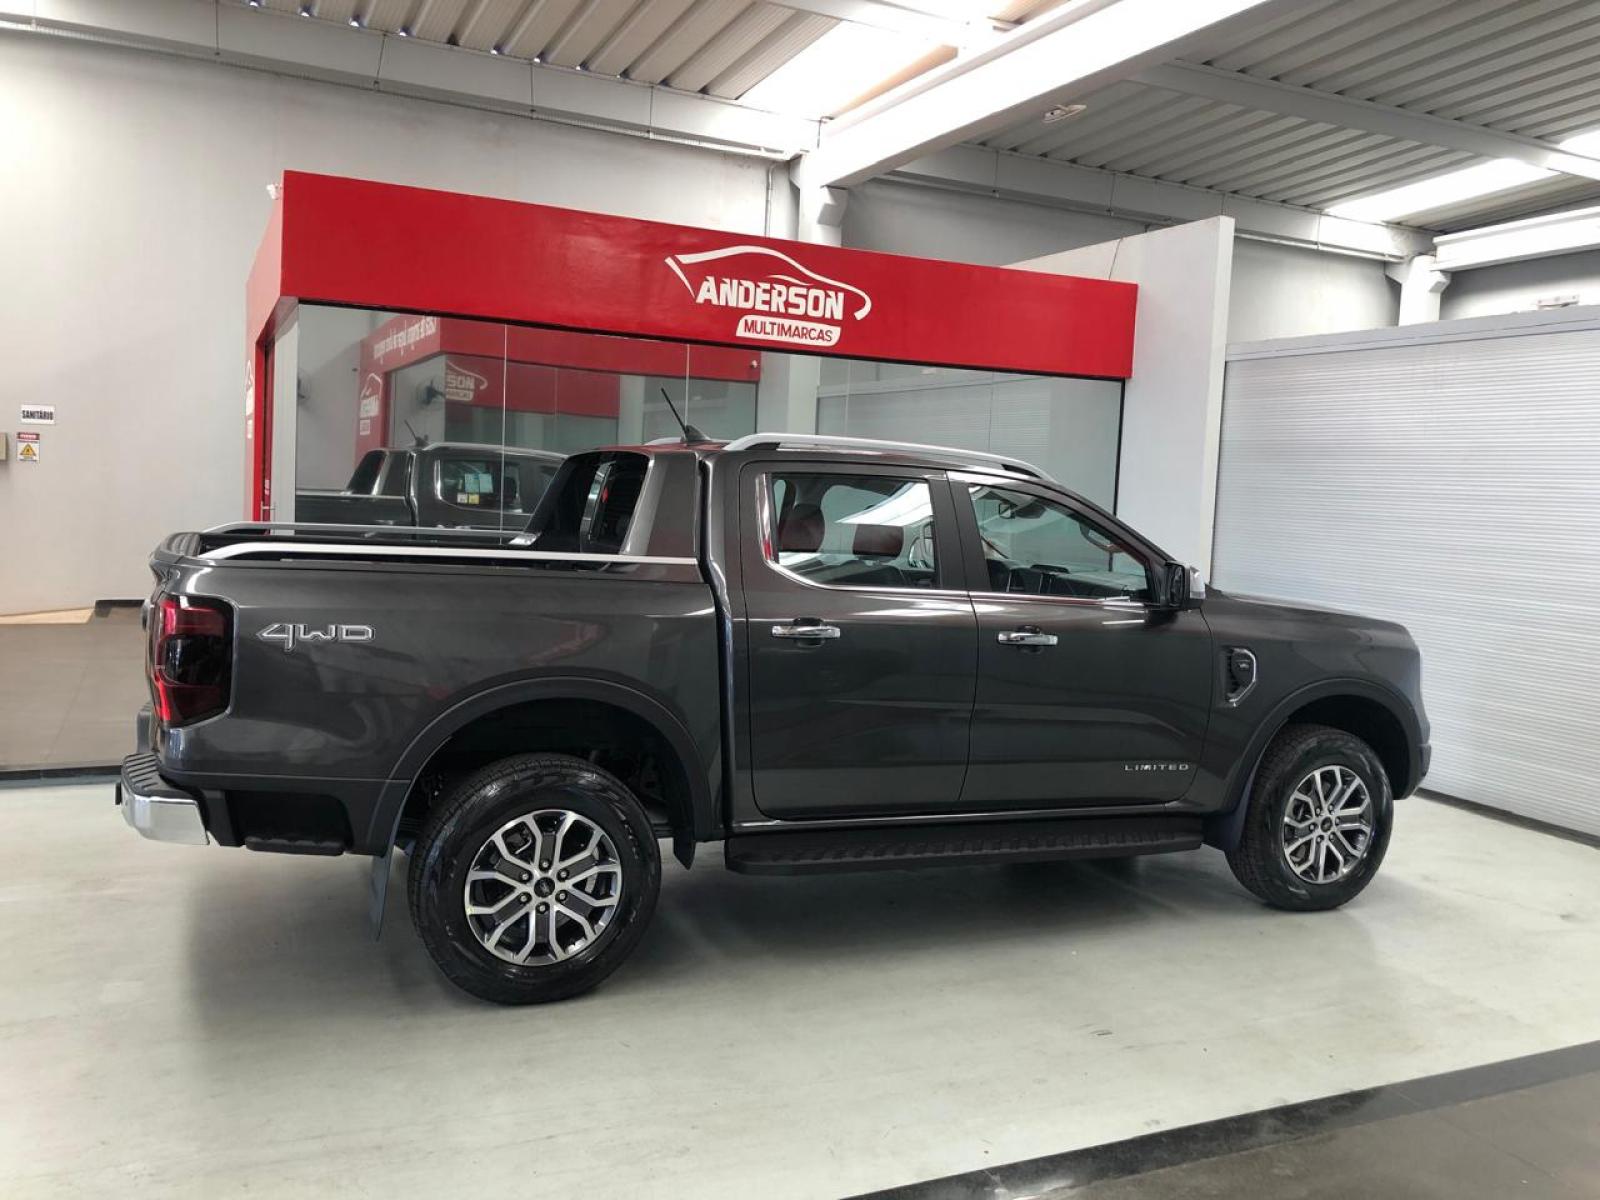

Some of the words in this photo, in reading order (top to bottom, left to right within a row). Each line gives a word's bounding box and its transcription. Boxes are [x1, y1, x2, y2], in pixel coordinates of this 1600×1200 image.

[695, 275, 845, 320] ANDERSON
[743, 318, 833, 342] MULTIMARCAS
[21, 409, 54, 421] SANITÁRIO
[256, 622, 377, 653] 4WD
[1123, 763, 1190, 771] LIMITED
